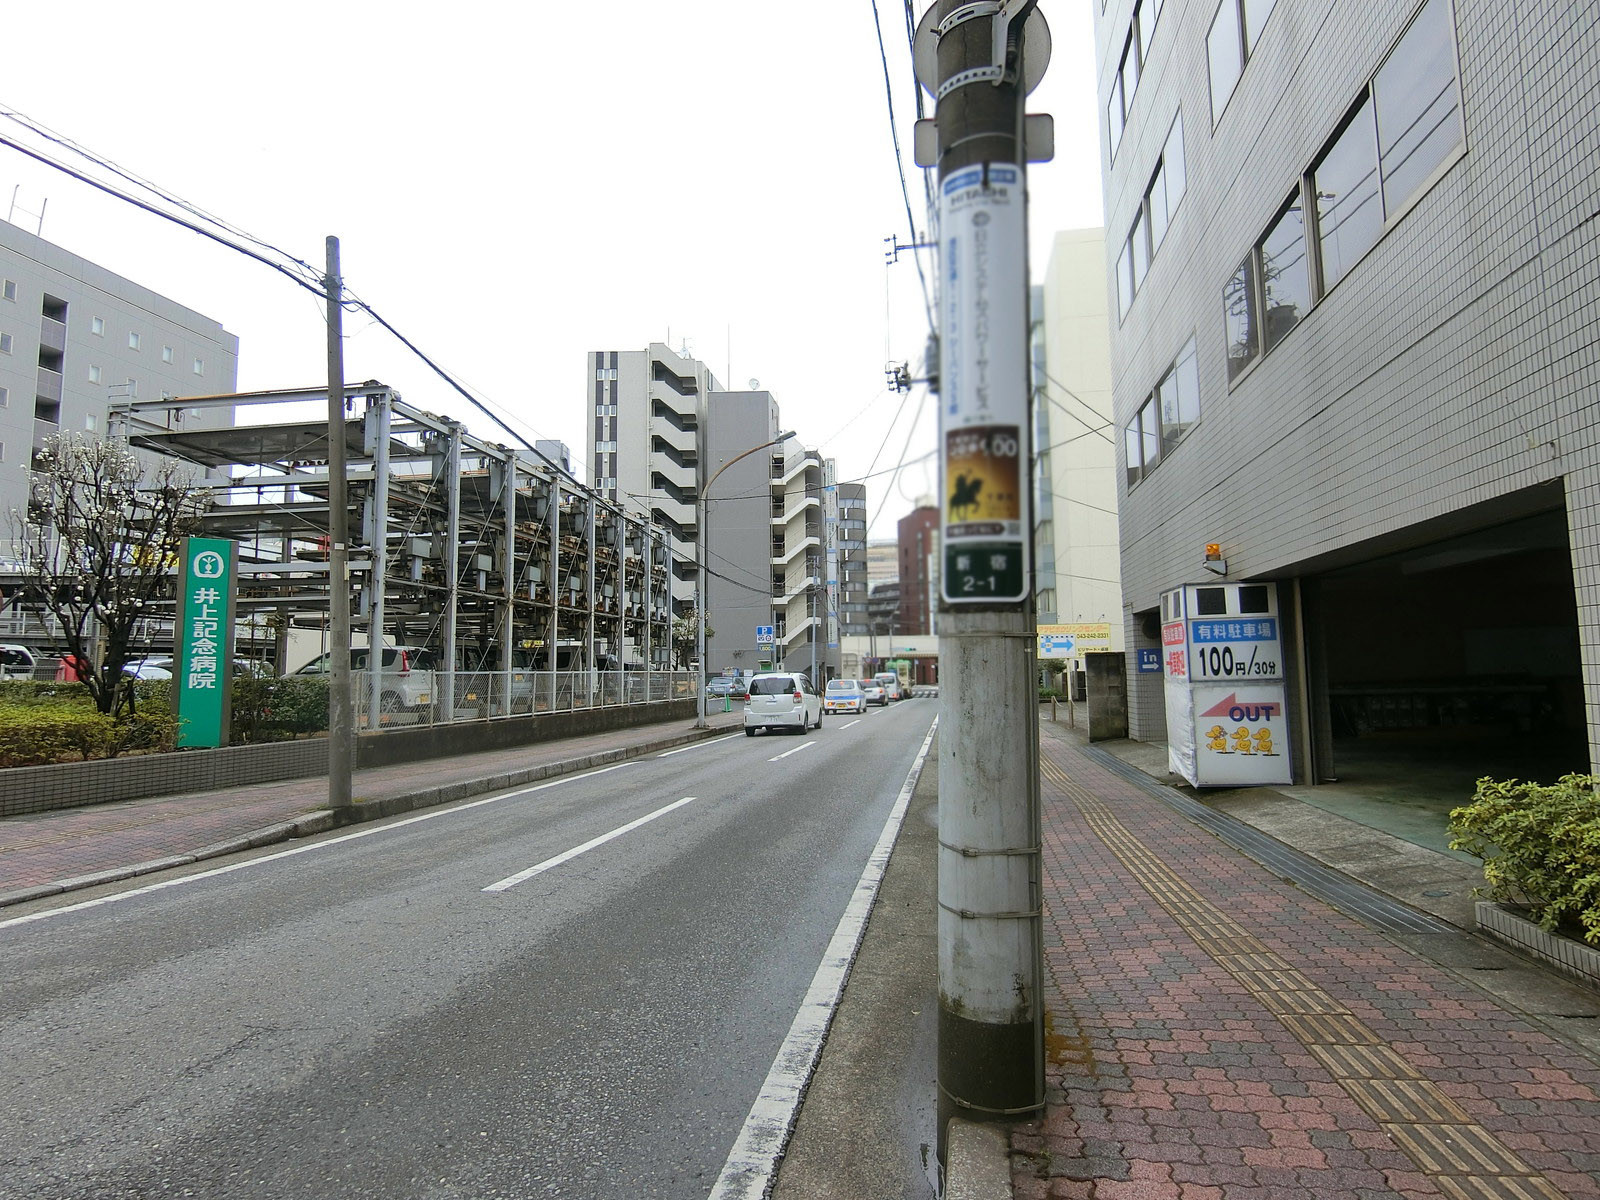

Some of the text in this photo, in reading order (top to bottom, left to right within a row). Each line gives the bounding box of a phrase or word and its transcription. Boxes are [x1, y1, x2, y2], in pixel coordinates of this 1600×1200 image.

[963, 575, 996, 592] 2-1
[188, 587, 220, 690] 井上記念病院
[761, 627, 768, 635] P
[1198, 622, 1271, 640] 有料駐車場
[1143, 651, 1157, 662] in
[1199, 645, 1276, 677] 100円/30分
[1229, 706, 1274, 722] OUT
